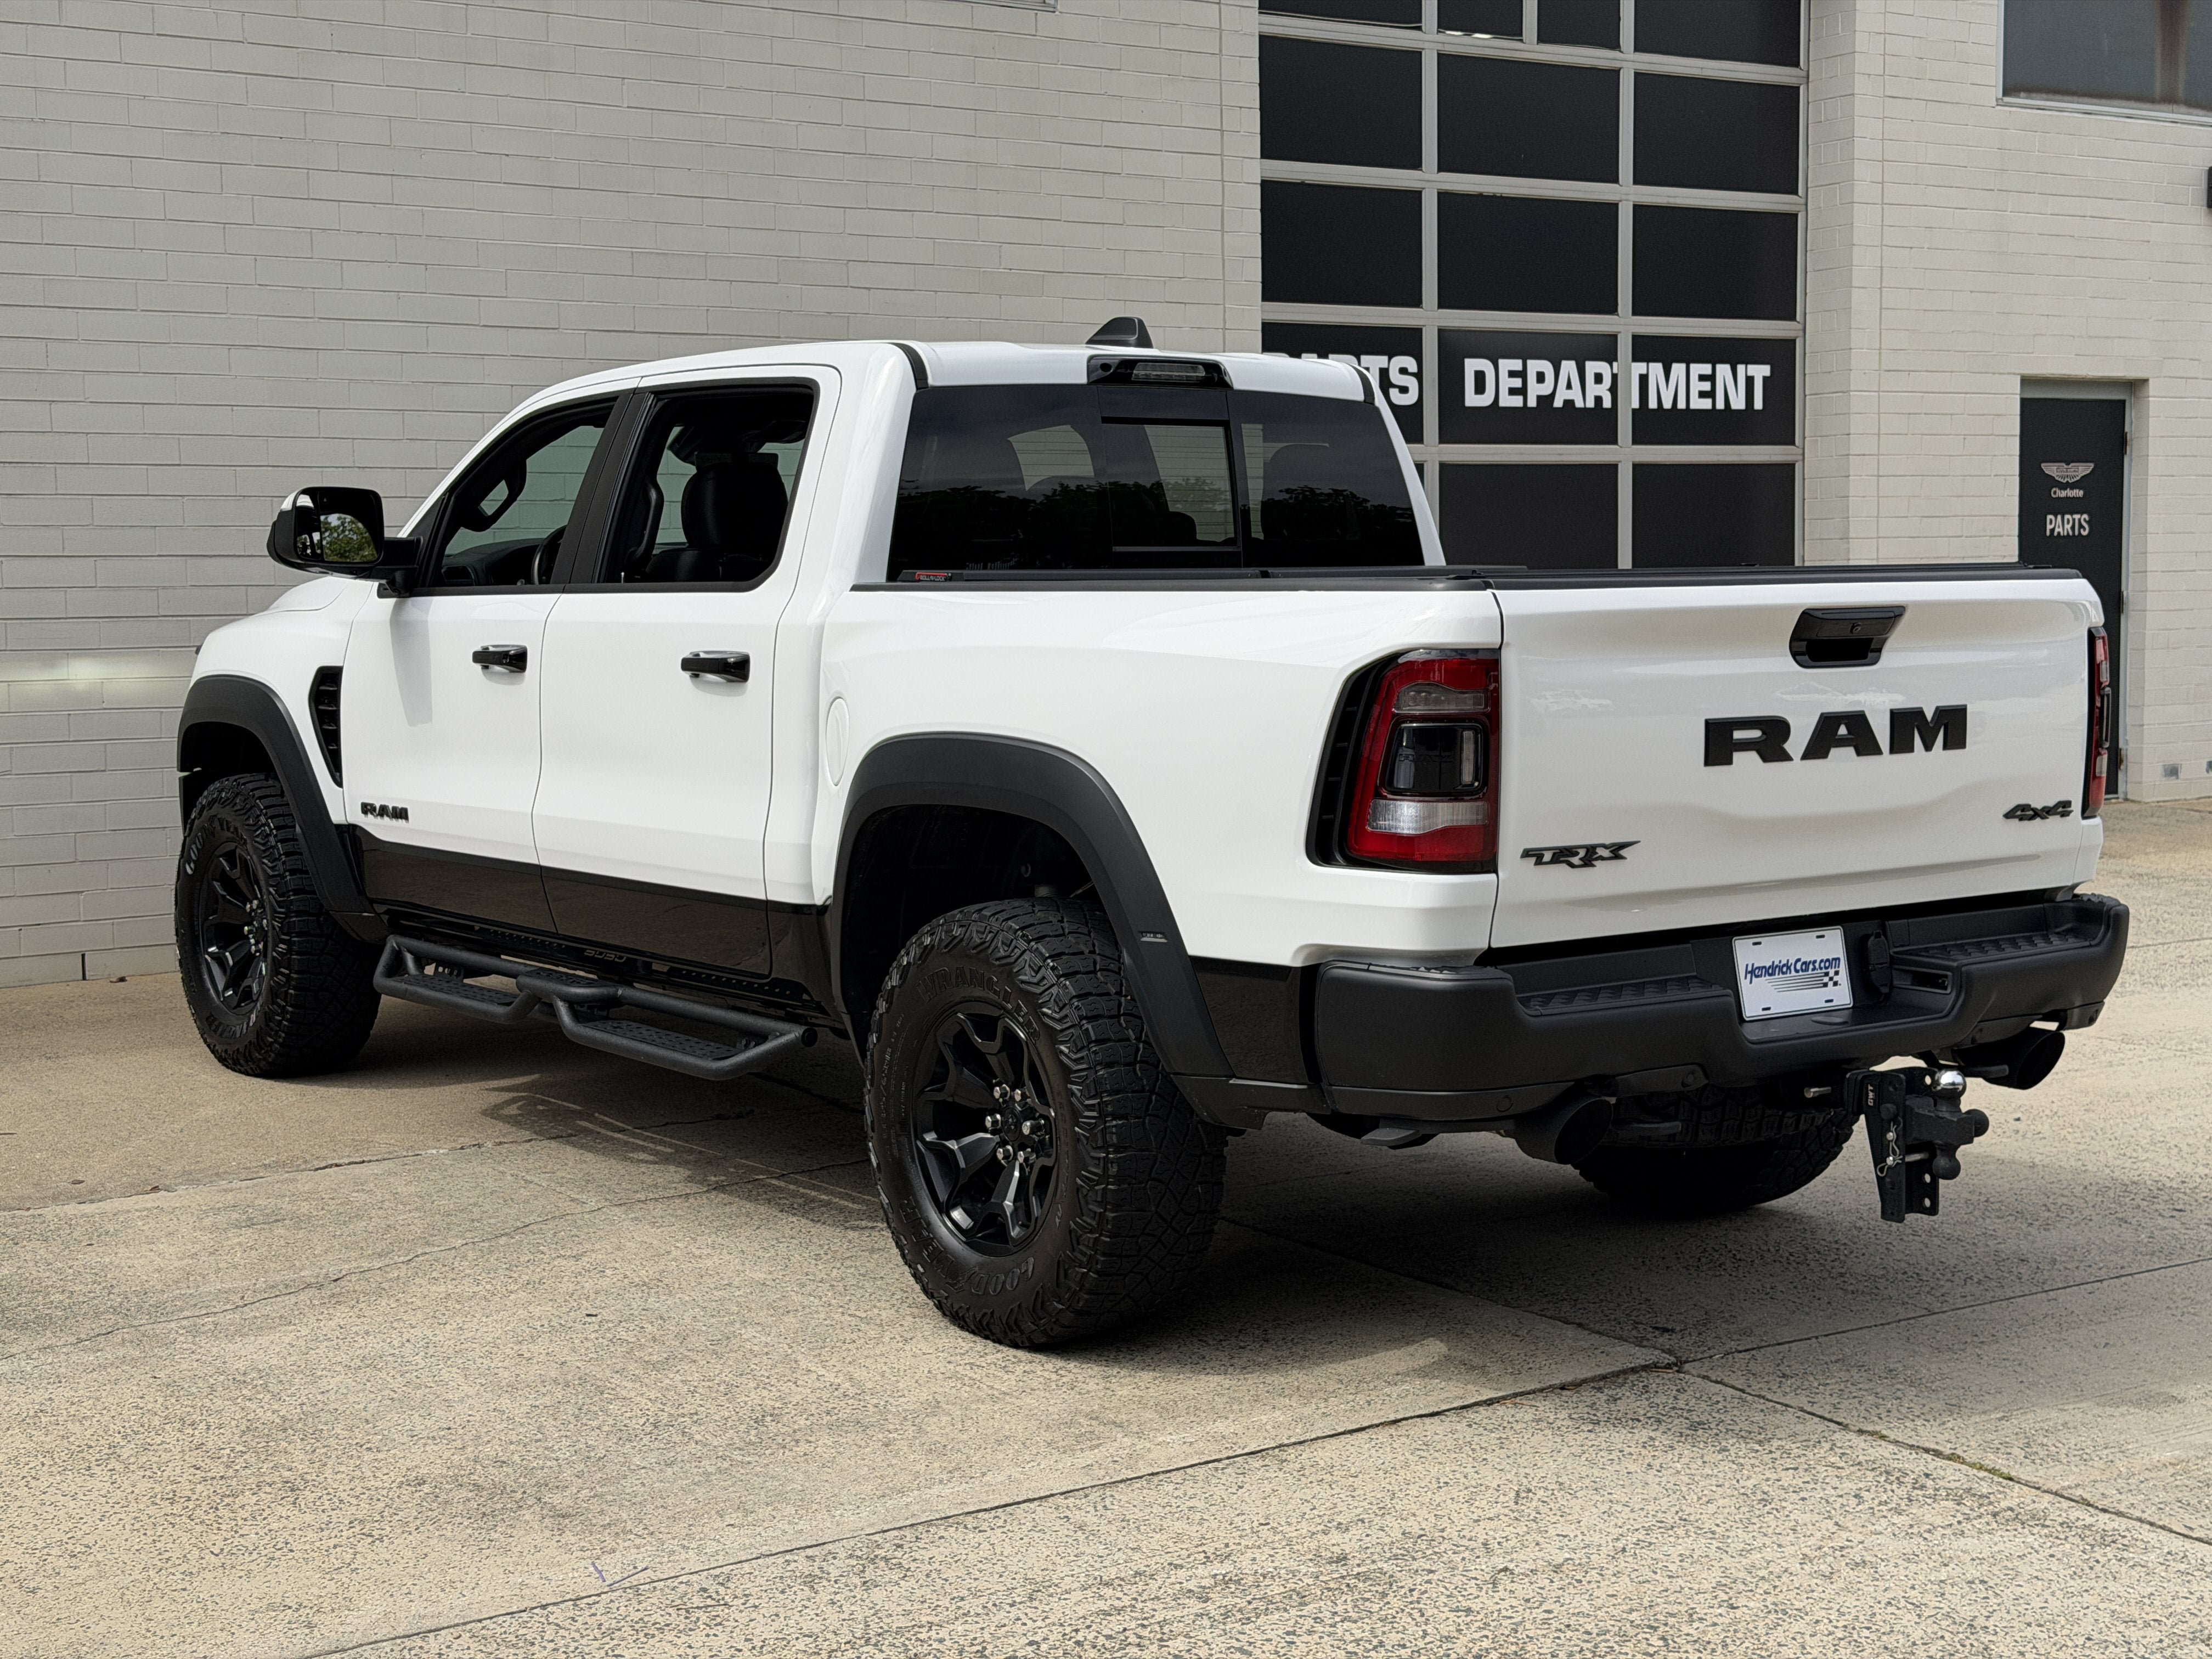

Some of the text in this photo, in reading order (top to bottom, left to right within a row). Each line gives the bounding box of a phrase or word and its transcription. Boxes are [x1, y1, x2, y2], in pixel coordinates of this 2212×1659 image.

[1464, 358, 1770, 410] DEPARTMENT
[2051, 487, 2084, 498] Charlotte
[2046, 514, 2089, 537] PARTS
[1703, 704, 1967, 767] RAM
[360, 802, 409, 823] RAM
[1520, 840, 1641, 868] TRX
[917, 966, 1040, 1041] WRANGLER
